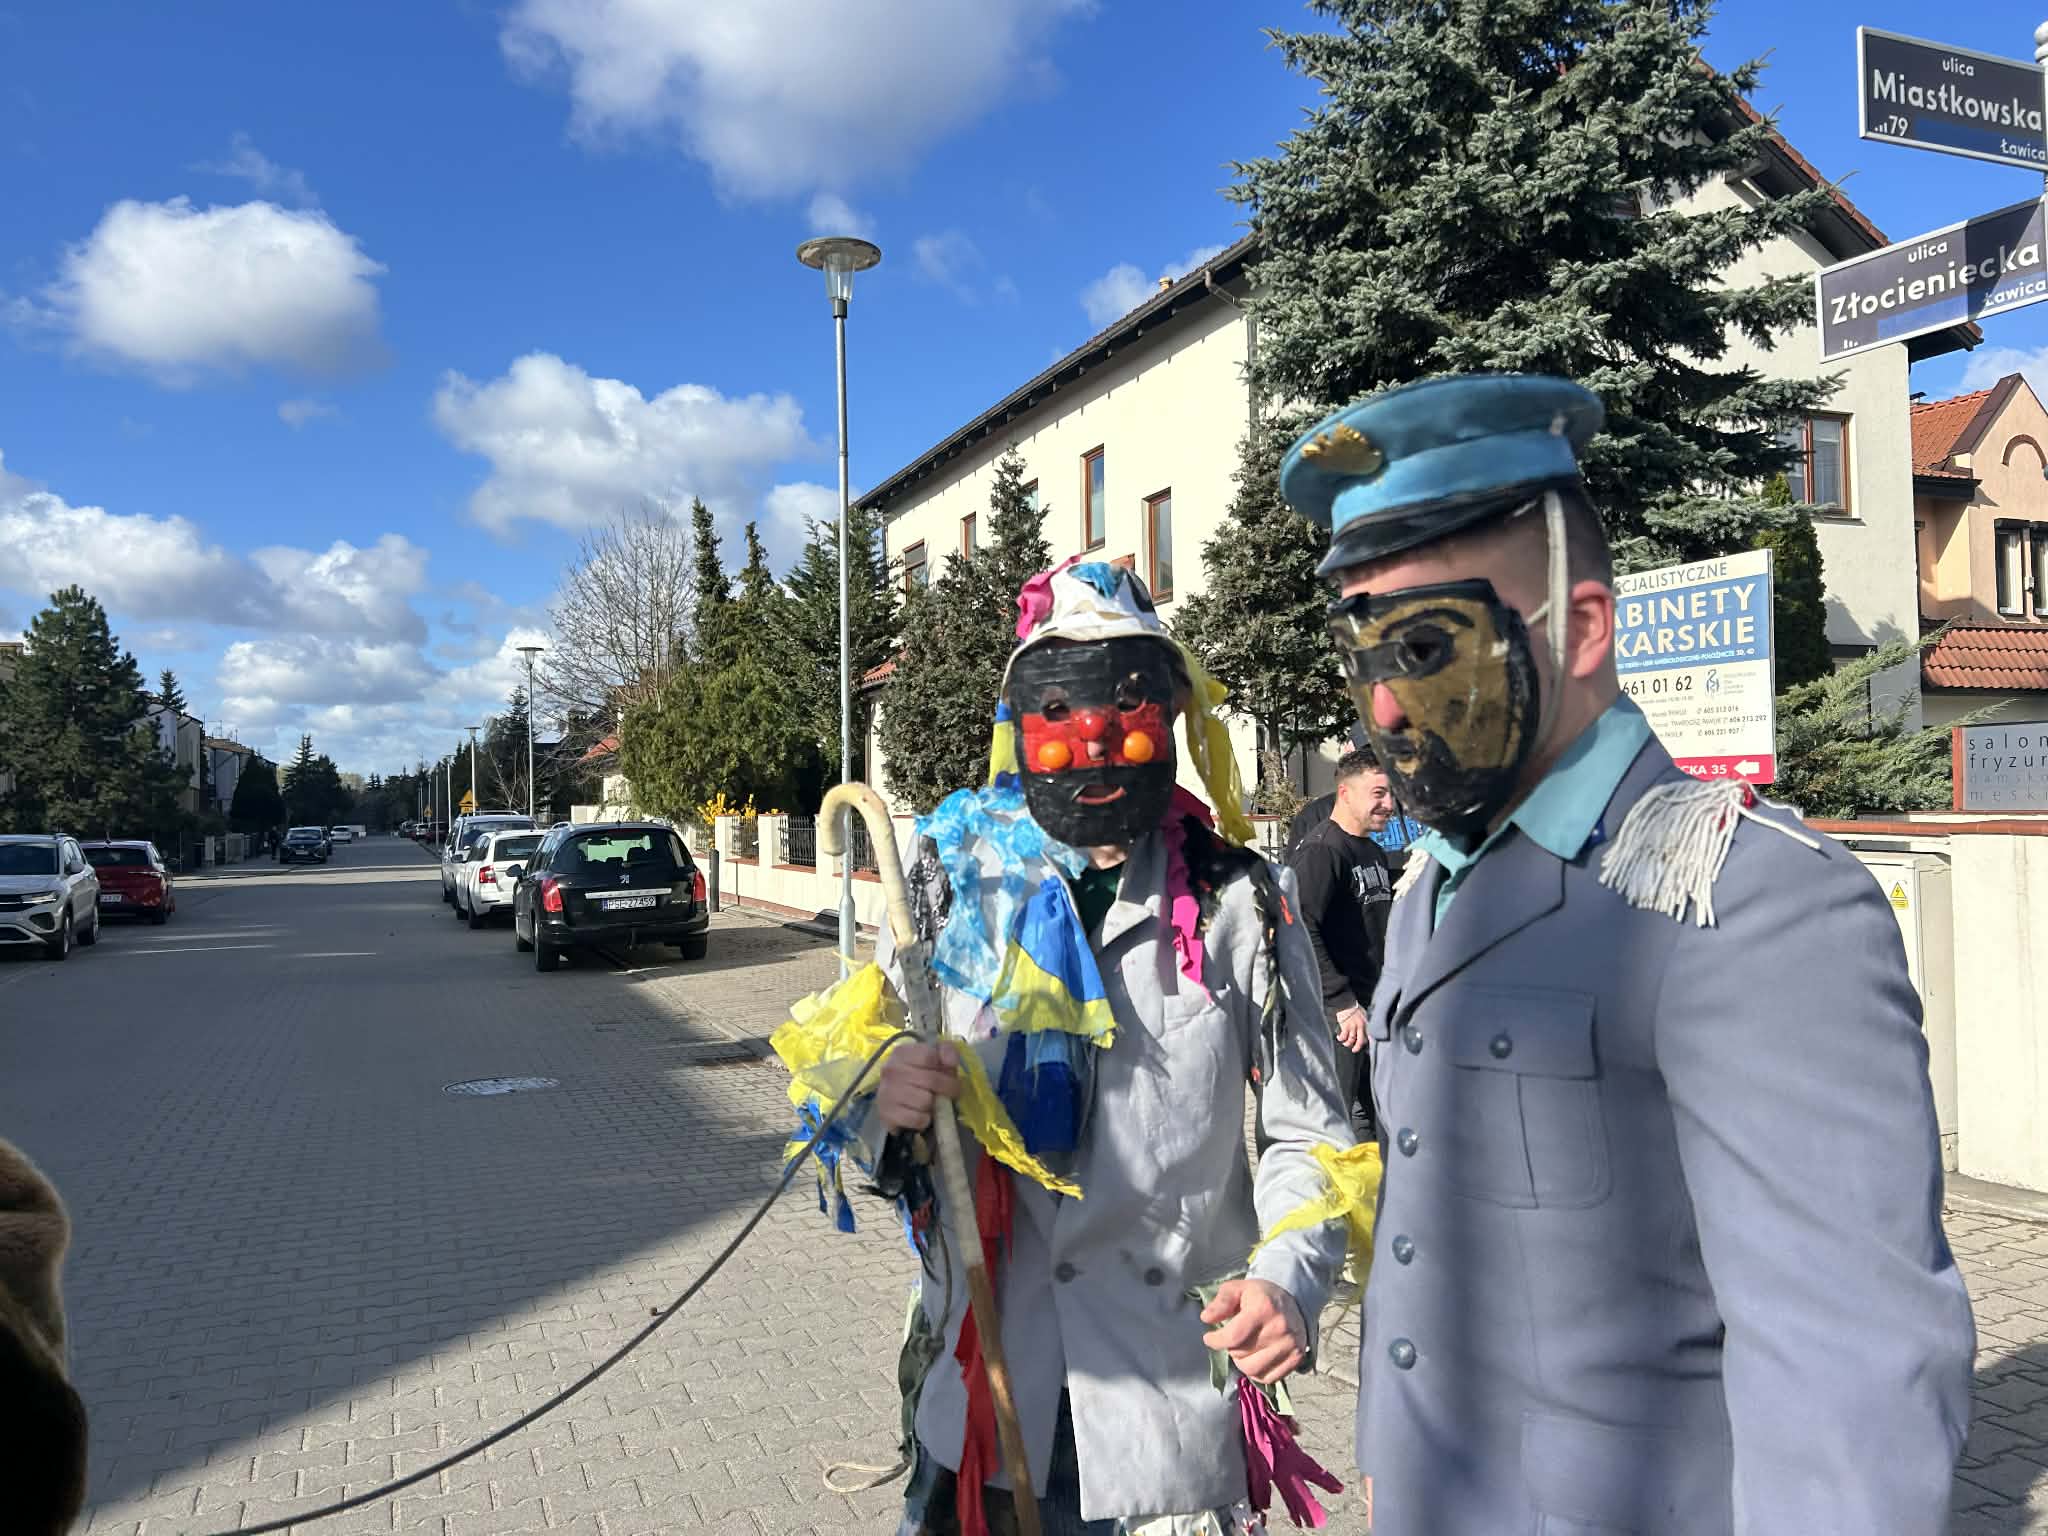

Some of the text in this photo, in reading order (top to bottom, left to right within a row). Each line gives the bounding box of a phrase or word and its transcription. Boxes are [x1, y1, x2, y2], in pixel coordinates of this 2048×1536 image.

[1942, 57, 1975, 77] ulica
[1873, 68, 2043, 132] Miastkowska
[1888, 115, 1909, 137] 79
[2000, 138, 2046, 161] Ławica
[1908, 241, 1948, 264] ulica
[1831, 243, 2040, 325] Złocieniecka
[1985, 279, 2047, 307] Ławica
[1615, 616, 1756, 659] KARSKIE
[1623, 675, 1692, 696] 661 01 62
[1711, 763, 1728, 775] 35
